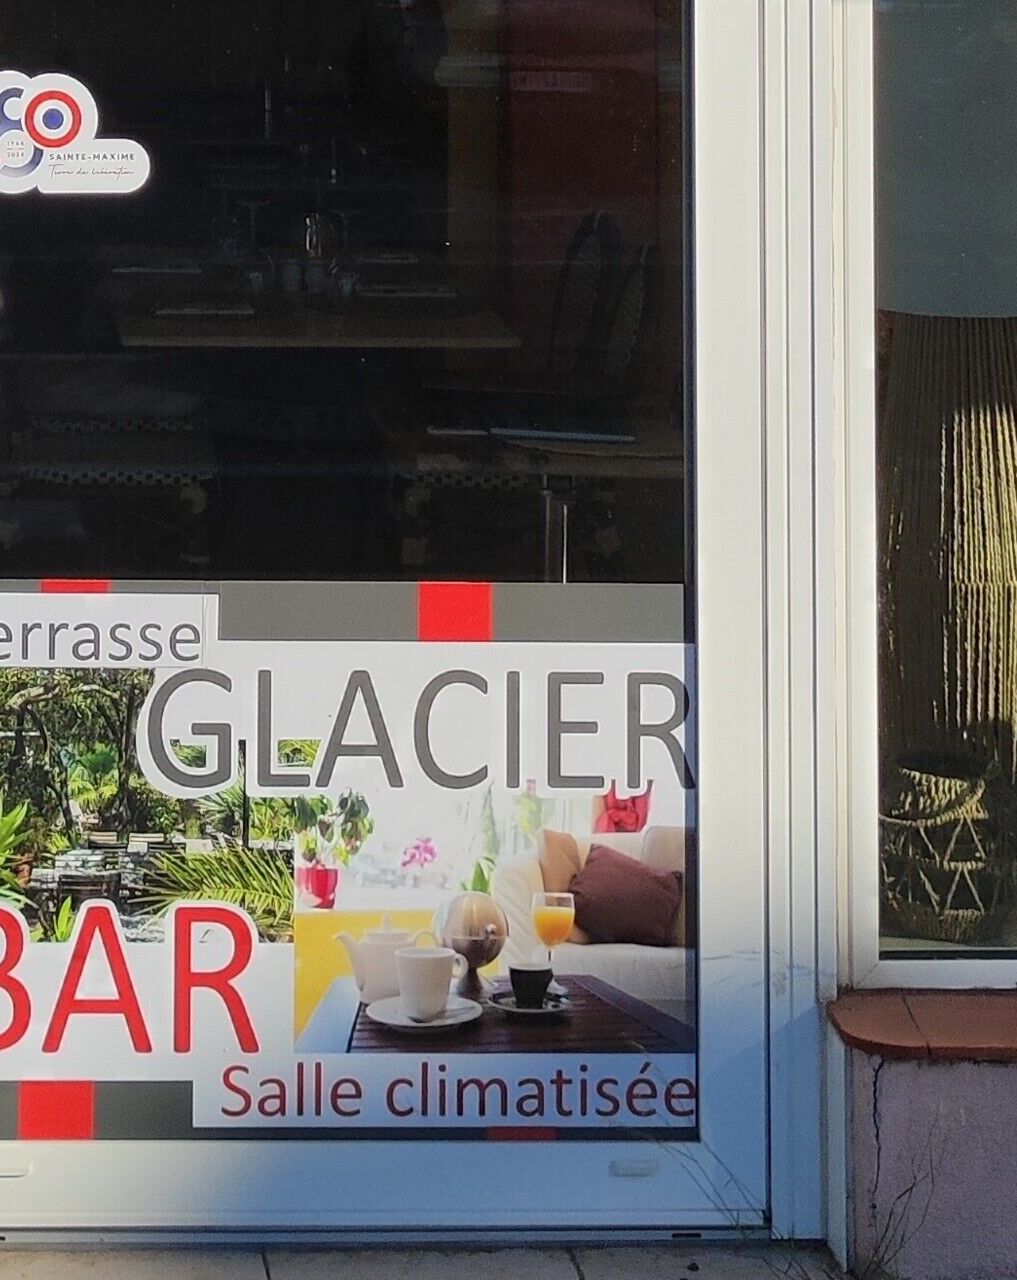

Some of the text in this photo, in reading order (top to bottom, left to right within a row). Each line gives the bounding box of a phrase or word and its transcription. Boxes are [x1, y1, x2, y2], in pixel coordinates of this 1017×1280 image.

[49, 153, 135, 161] SAINTE-MAXIME
[146, 668, 696, 790] GLACIER
[220, 1061, 696, 1118] Salle climatisée
